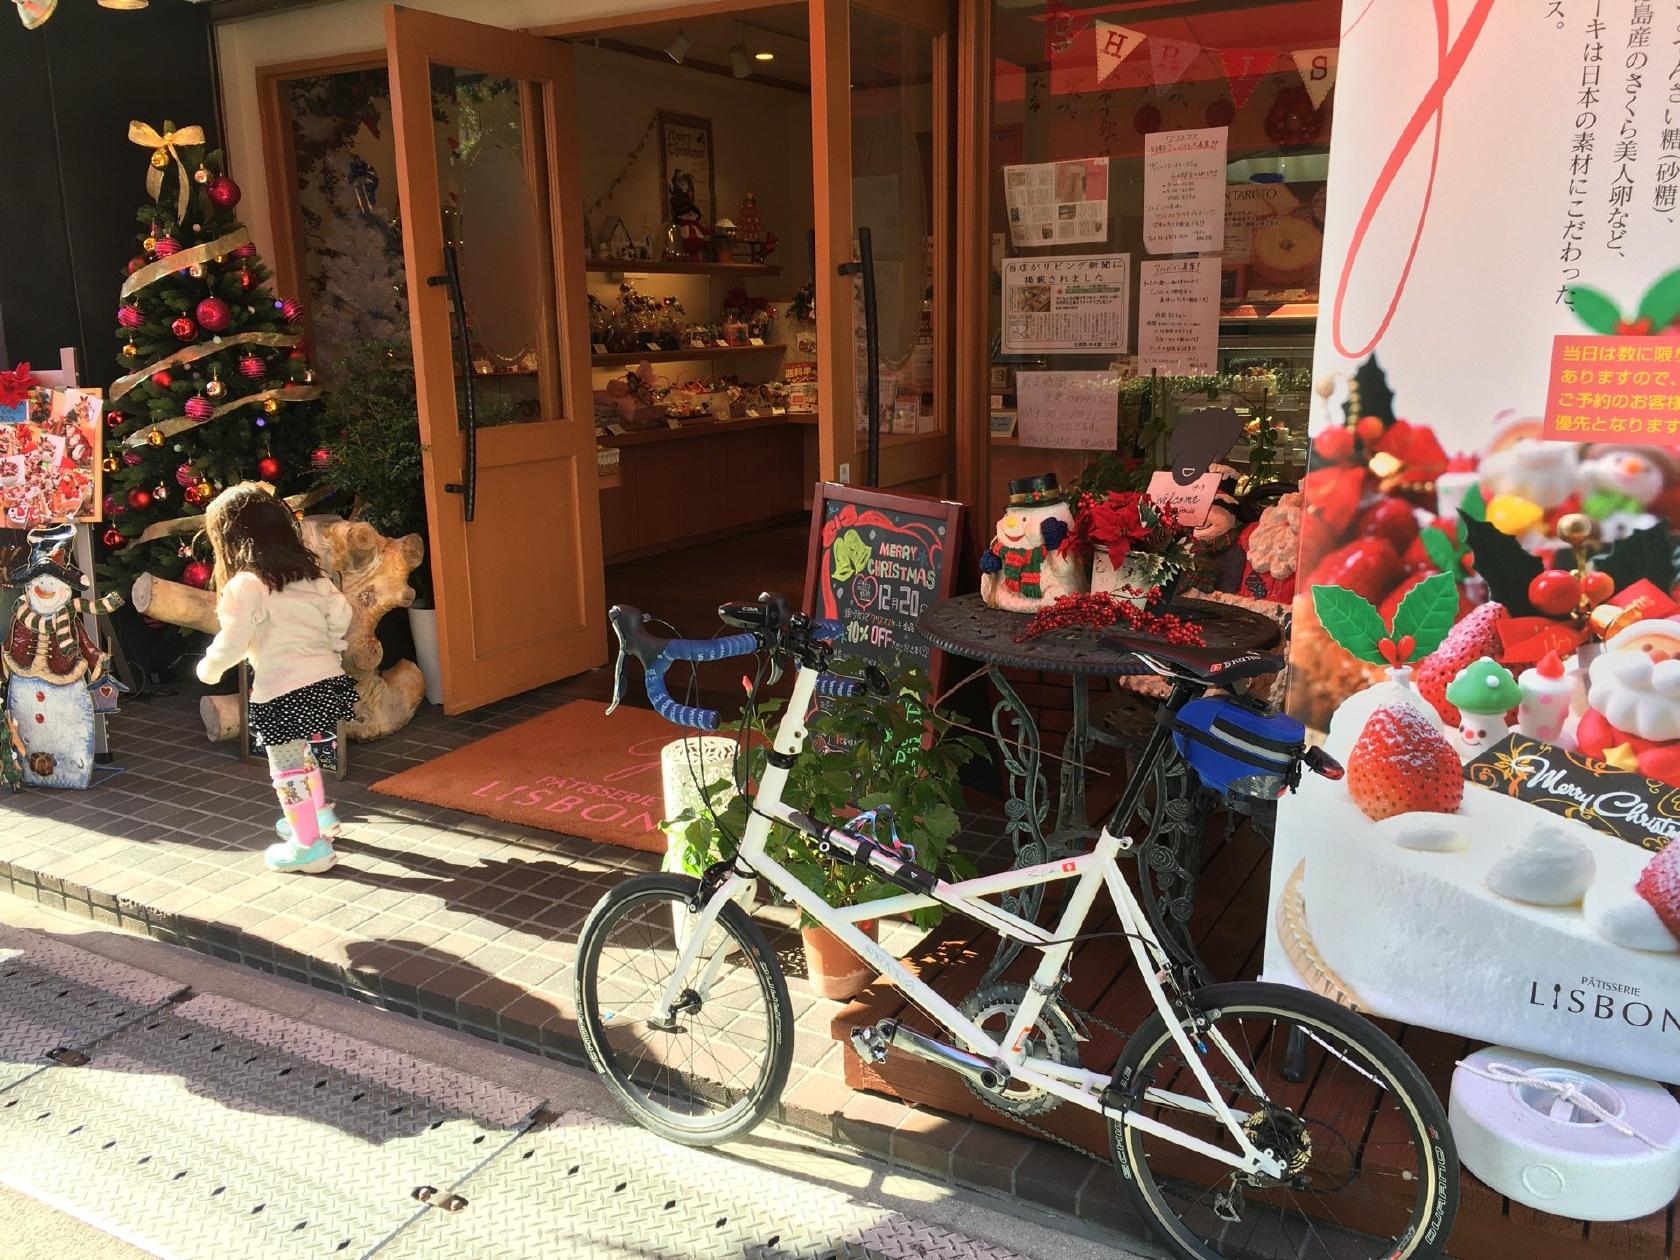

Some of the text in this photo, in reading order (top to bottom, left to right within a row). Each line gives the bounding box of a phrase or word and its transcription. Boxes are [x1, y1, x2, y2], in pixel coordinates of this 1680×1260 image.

[1105, 30, 1128, 59] H
[1310, 55, 1328, 81] S
[1606, 0, 1653, 257] 島産のさくら美人卵など、
[1563, 344, 1680, 362] 当日は数に限
[1560, 367, 1677, 386] ありますので、
[879, 541, 918, 561] MERRY
[867, 558, 936, 590] CHRISTMAS
[846, 620, 893, 648] 10% OFF
[1511, 754, 1595, 811] Merry
[1581, 976, 1641, 998] PÂTISSERIE
[1424, 1145, 1447, 1246] DURANO
